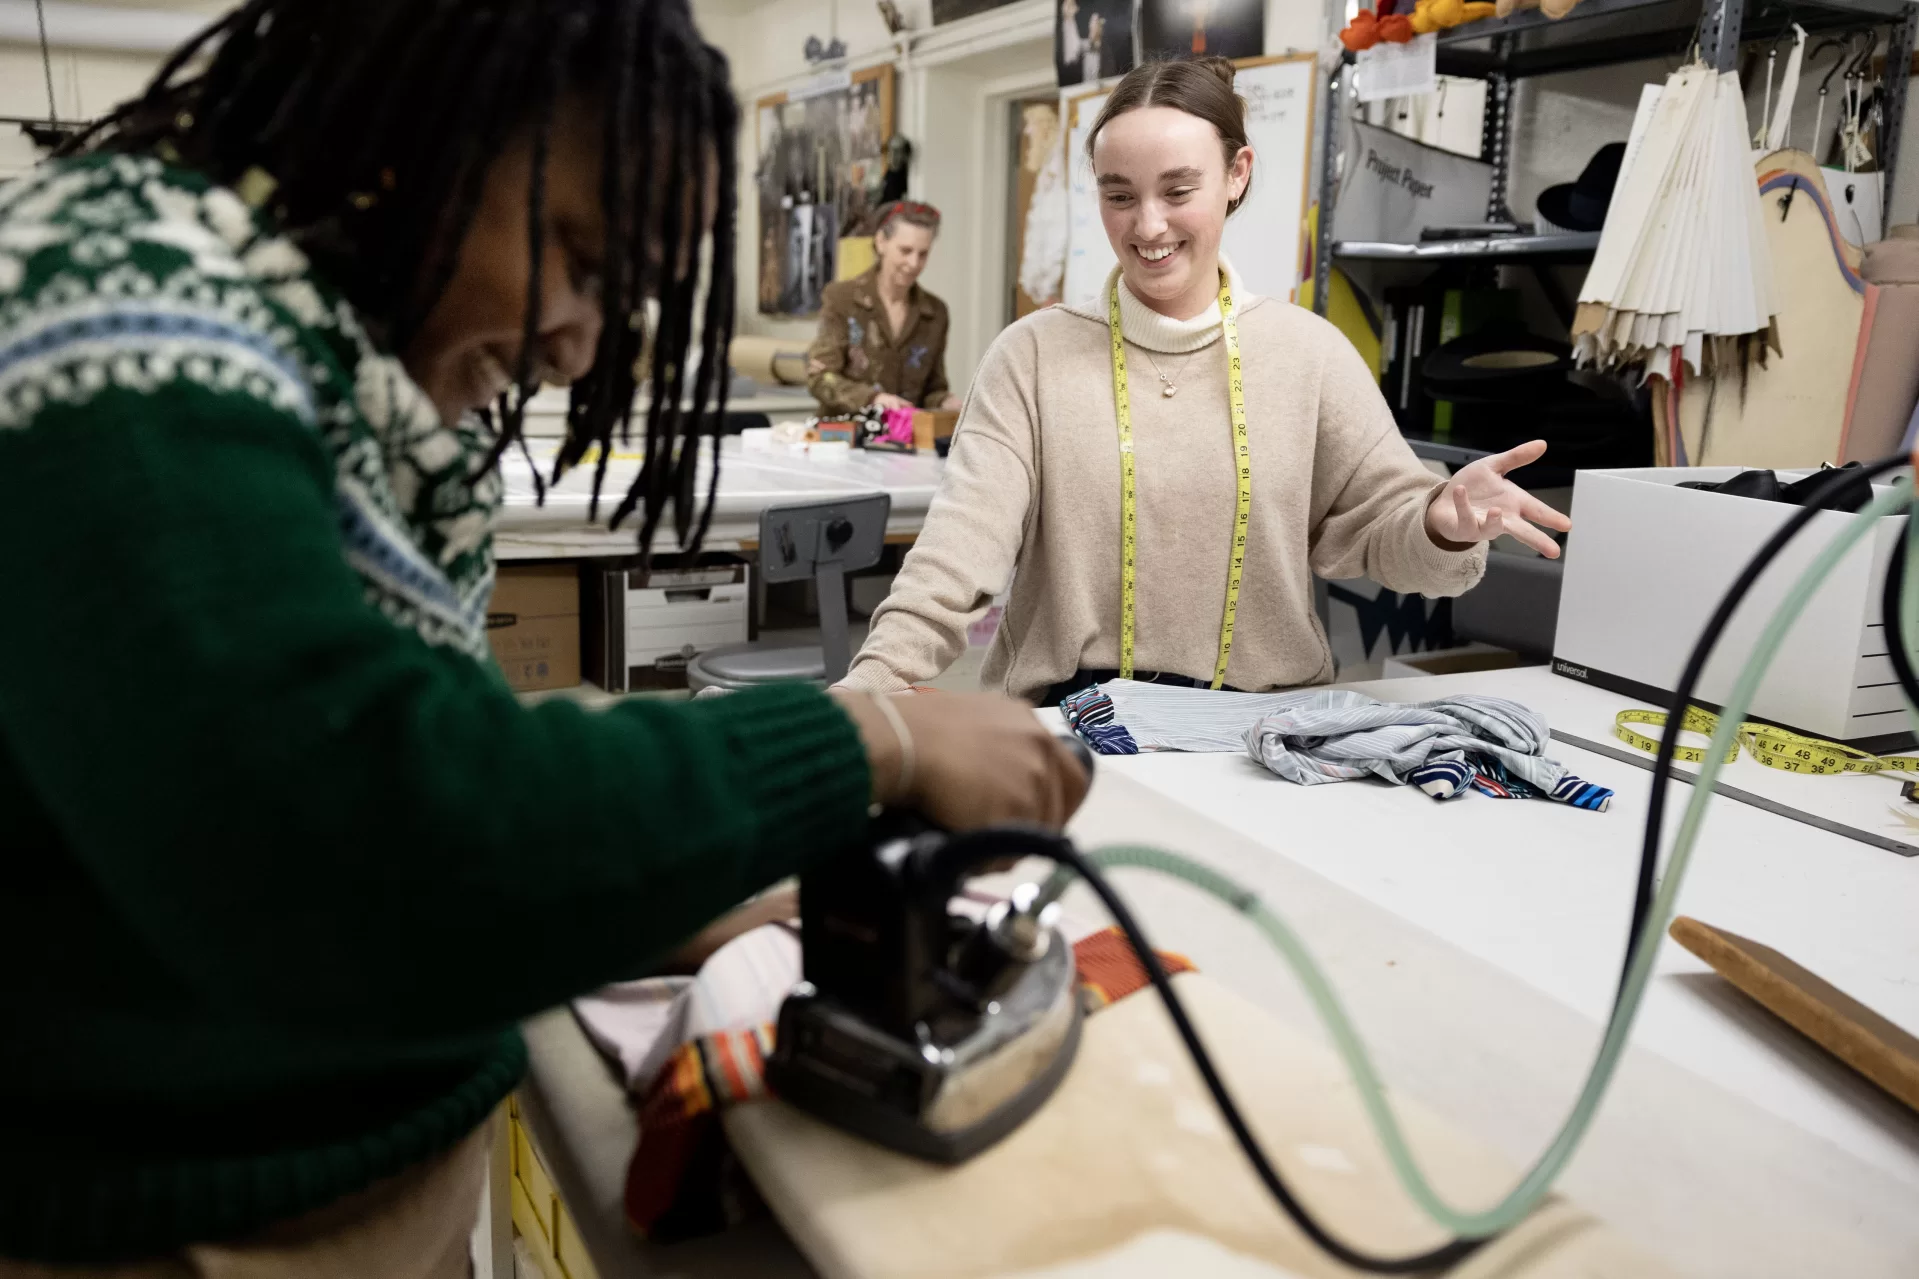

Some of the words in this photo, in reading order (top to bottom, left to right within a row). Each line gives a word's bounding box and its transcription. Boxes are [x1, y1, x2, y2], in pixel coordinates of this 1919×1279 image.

[1366, 149, 1400, 184] Project
[1401, 168, 1434, 199] Paper
[1222, 295, 1232, 307] 26
[1229, 335, 1239, 348] 24
[1232, 357, 1241, 370] 23
[1234, 379, 1242, 392] 22
[1236, 402, 1244, 414] 21
[1238, 423, 1247, 436] 20
[1240, 445, 1249, 457] 19
[1242, 467, 1250, 479] 18
[1242, 491, 1250, 503] 17
[1240, 513, 1248, 525] 16
[1237, 535, 1246, 547] 15
[1234, 557, 1243, 569] 14
[1232, 579, 1240, 590] 13
[1229, 600, 1237, 612] 12
[1226, 622, 1234, 633] 11
[1223, 643, 1231, 654] 10
[1218, 668, 1225, 676] 9
[1627, 734, 1634, 744] 18
[1641, 740, 1652, 751] 19
[1685, 751, 1699, 762] 21
[1758, 740, 1767, 749] 46
[1772, 743, 1786, 753] 47
[1795, 749, 1811, 760] 48
[1821, 757, 1836, 767] 49
[1843, 763, 1856, 771] 50
[1861, 765, 1873, 773] 51
[1891, 761, 1905, 770] 53
[1761, 755, 1773, 766] 36
[1784, 761, 1800, 772] 37
[1811, 765, 1825, 774] 38
